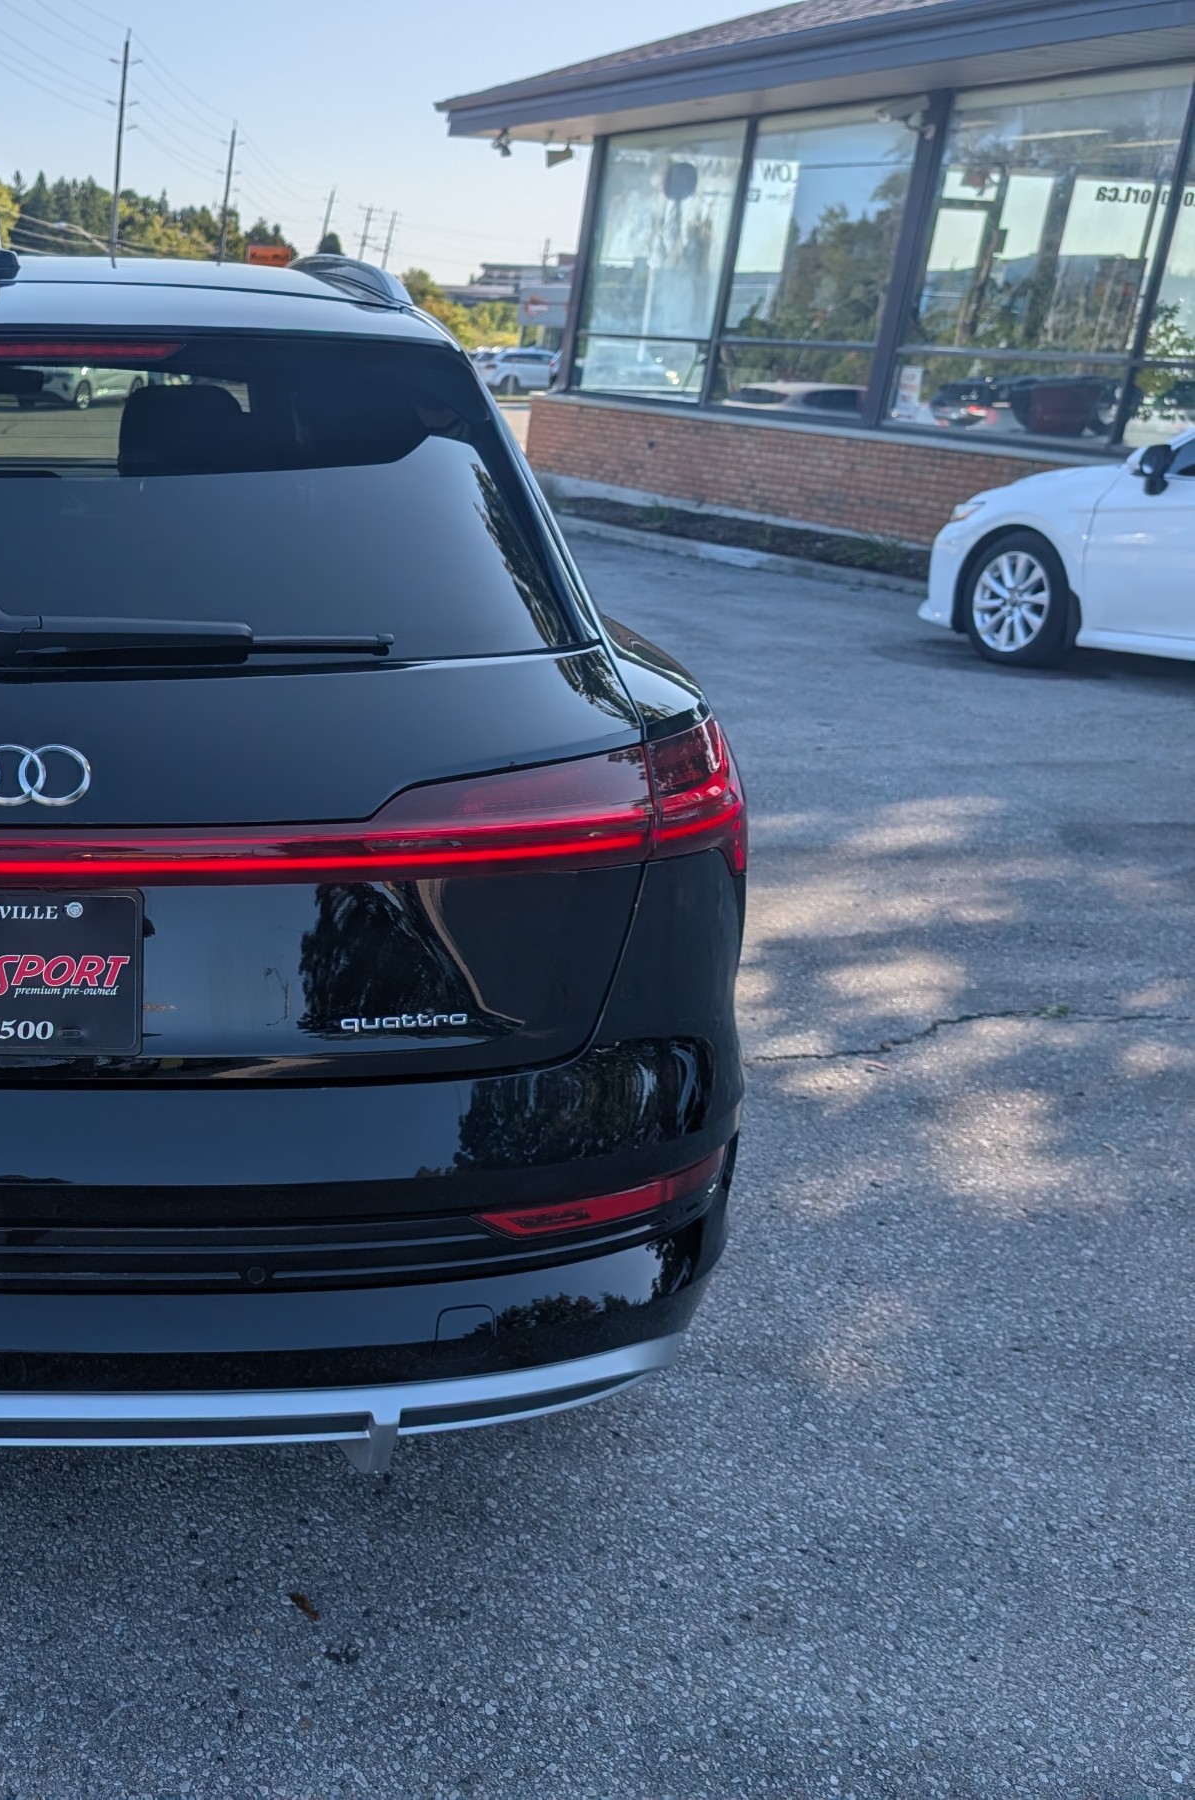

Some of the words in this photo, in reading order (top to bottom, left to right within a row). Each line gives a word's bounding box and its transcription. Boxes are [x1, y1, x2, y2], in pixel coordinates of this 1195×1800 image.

[14, 985, 61, 998] premium
[62, 985, 119, 998] pre-owned
[340, 1013, 468, 1033] quattro
